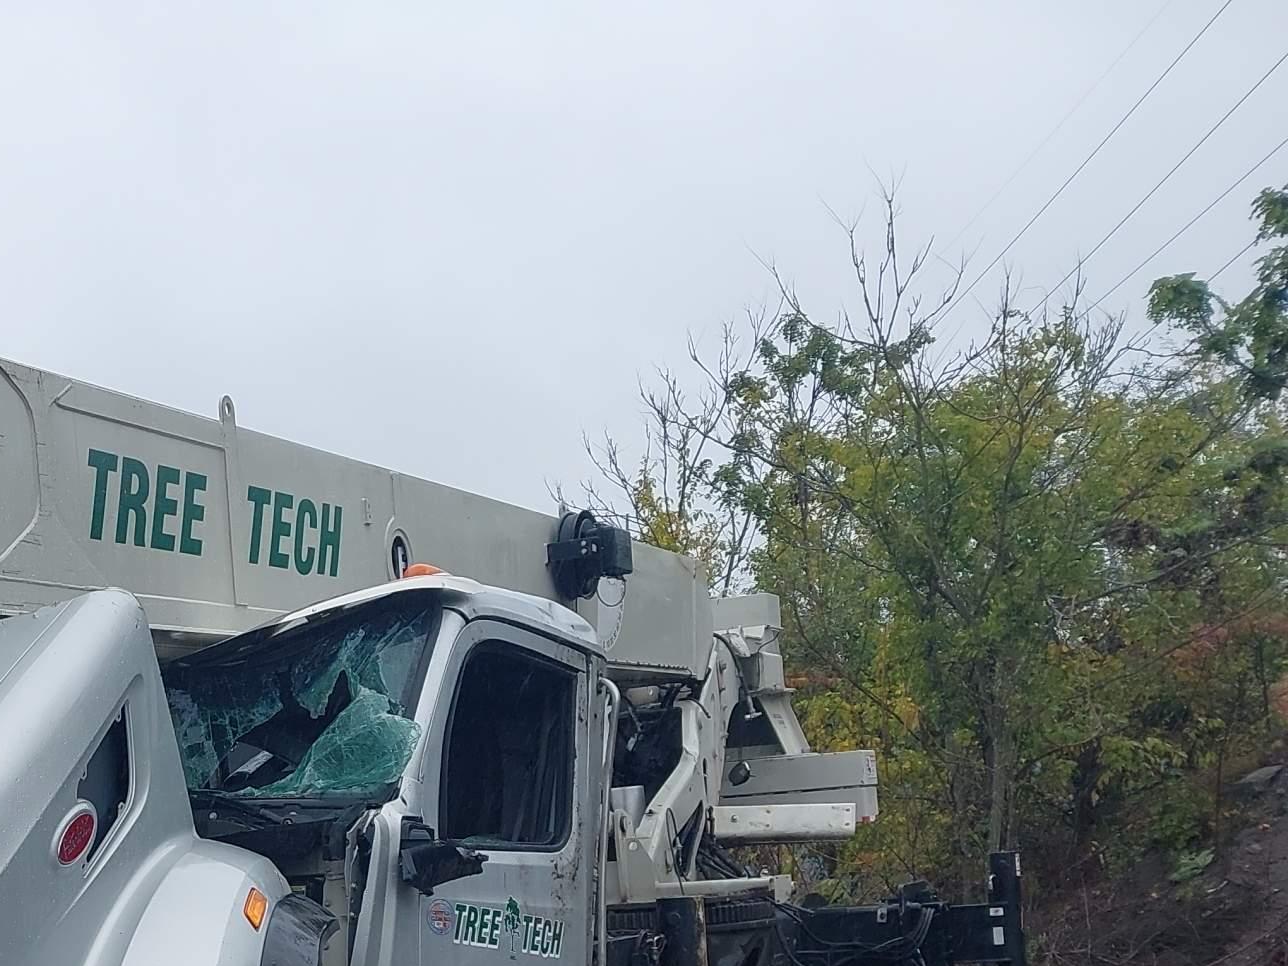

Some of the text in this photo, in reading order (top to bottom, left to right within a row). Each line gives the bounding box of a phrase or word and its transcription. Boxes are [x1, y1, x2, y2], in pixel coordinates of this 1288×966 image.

[87, 447, 343, 578] TREE TECH
[453, 903, 503, 949] TREE
[522, 914, 564, 958] TECH
